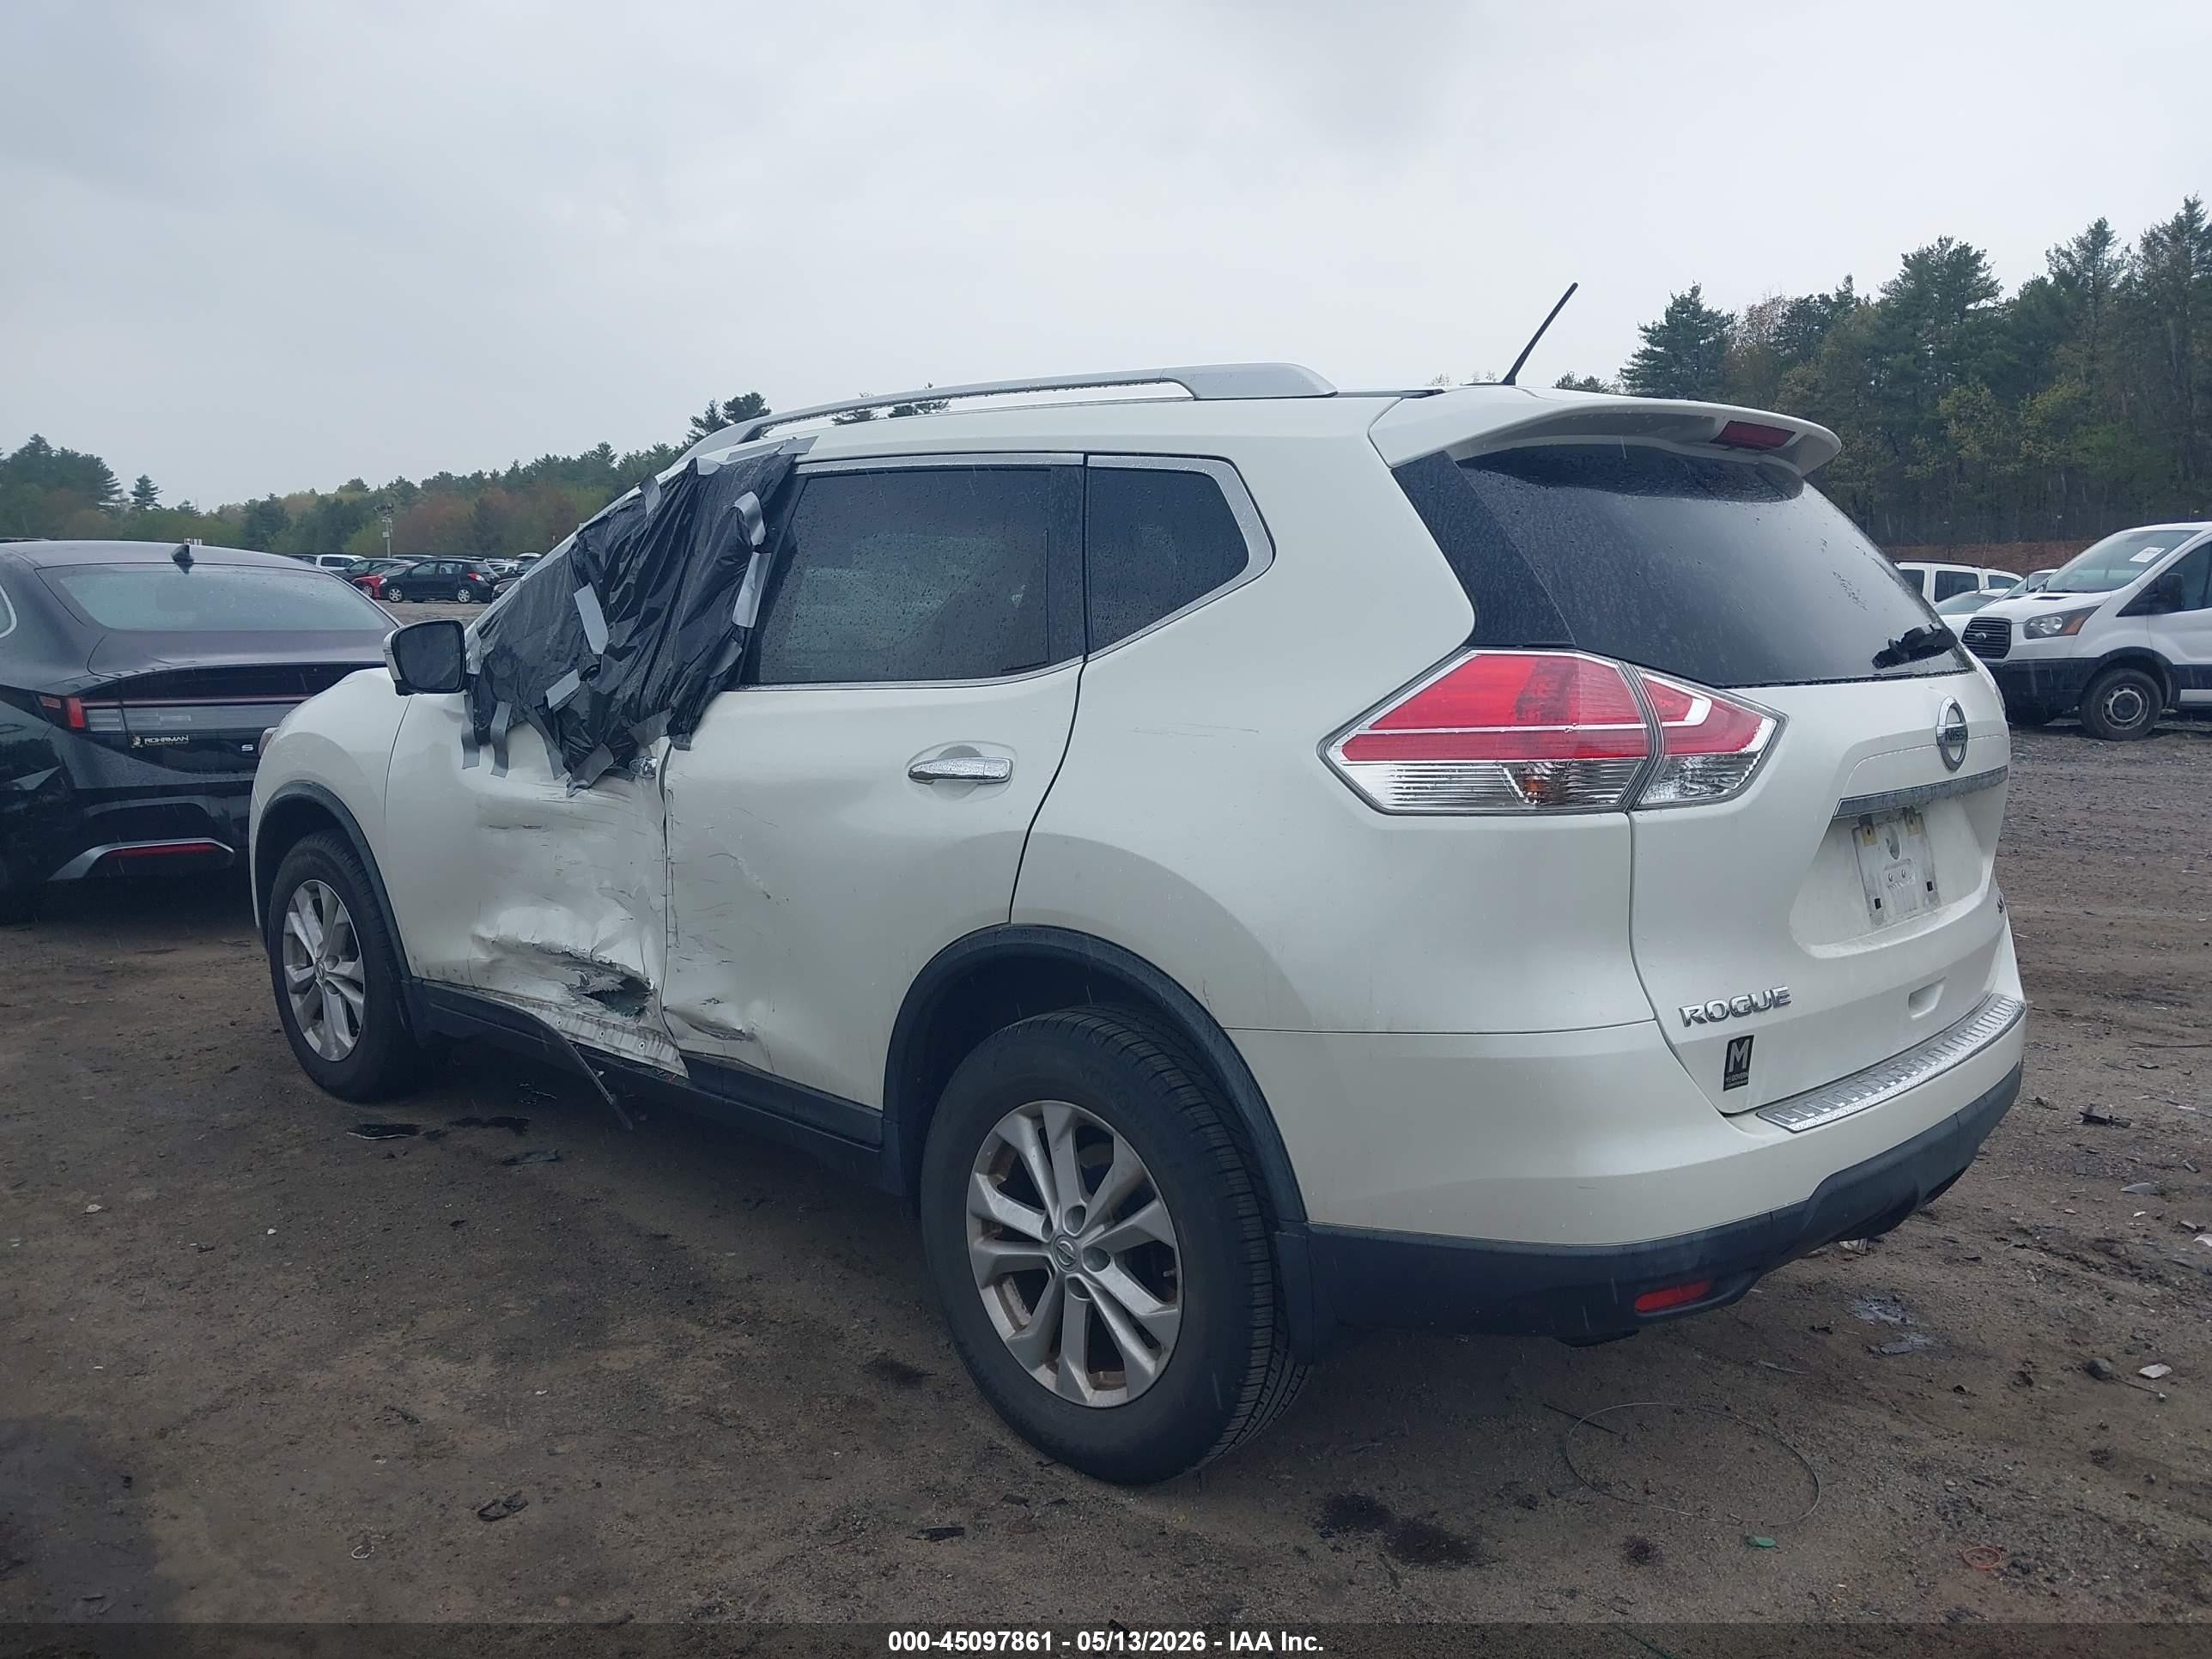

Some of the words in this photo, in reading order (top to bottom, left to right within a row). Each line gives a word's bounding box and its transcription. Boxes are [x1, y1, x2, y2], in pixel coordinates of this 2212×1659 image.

[144, 735, 189, 744] ROHRMAN
[1679, 985, 1793, 1028] ROGUE
[1729, 1039, 1750, 1073] M
